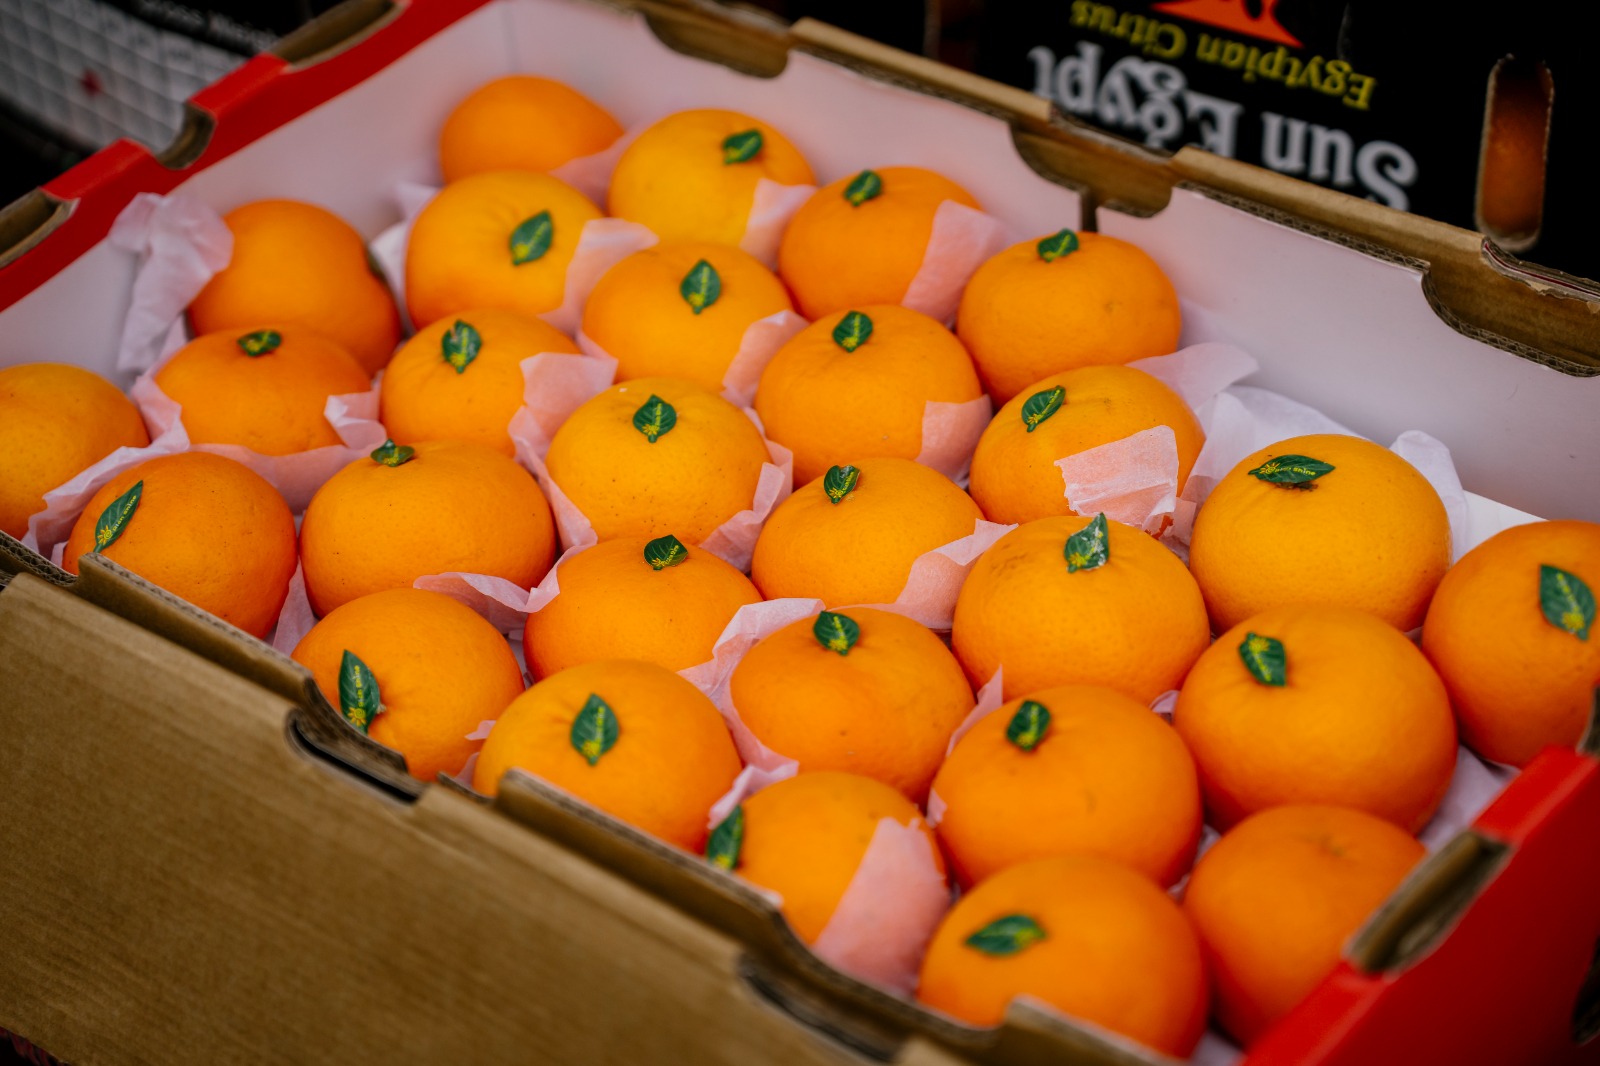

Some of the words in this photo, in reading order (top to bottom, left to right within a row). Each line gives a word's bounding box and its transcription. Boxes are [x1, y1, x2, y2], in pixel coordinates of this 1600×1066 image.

[1070, 1, 1187, 59] Citrus
[1027, 40, 1243, 158] Egypt
[1261, 110, 1418, 212] Sun
